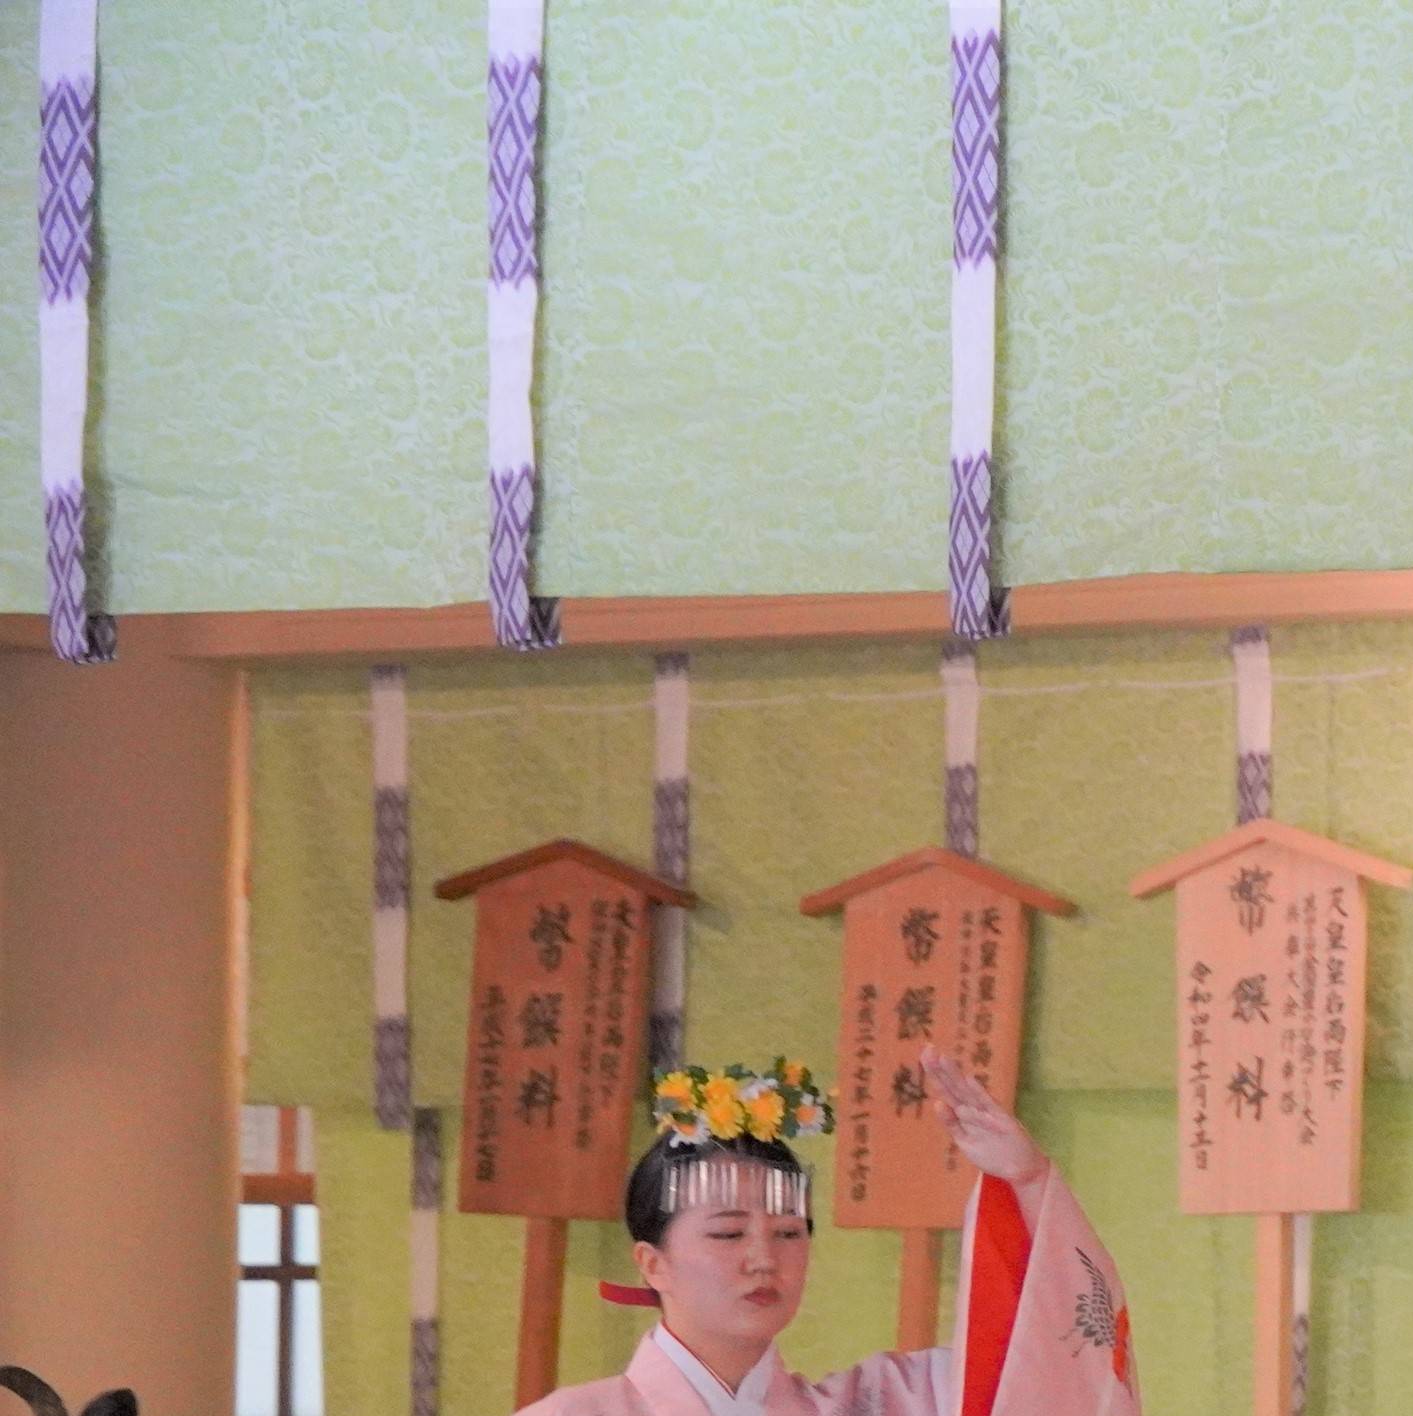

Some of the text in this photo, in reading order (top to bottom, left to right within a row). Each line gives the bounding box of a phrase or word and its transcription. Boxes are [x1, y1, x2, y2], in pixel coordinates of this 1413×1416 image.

[1323, 886, 1349, 1101] 天皇皇后両陛下
